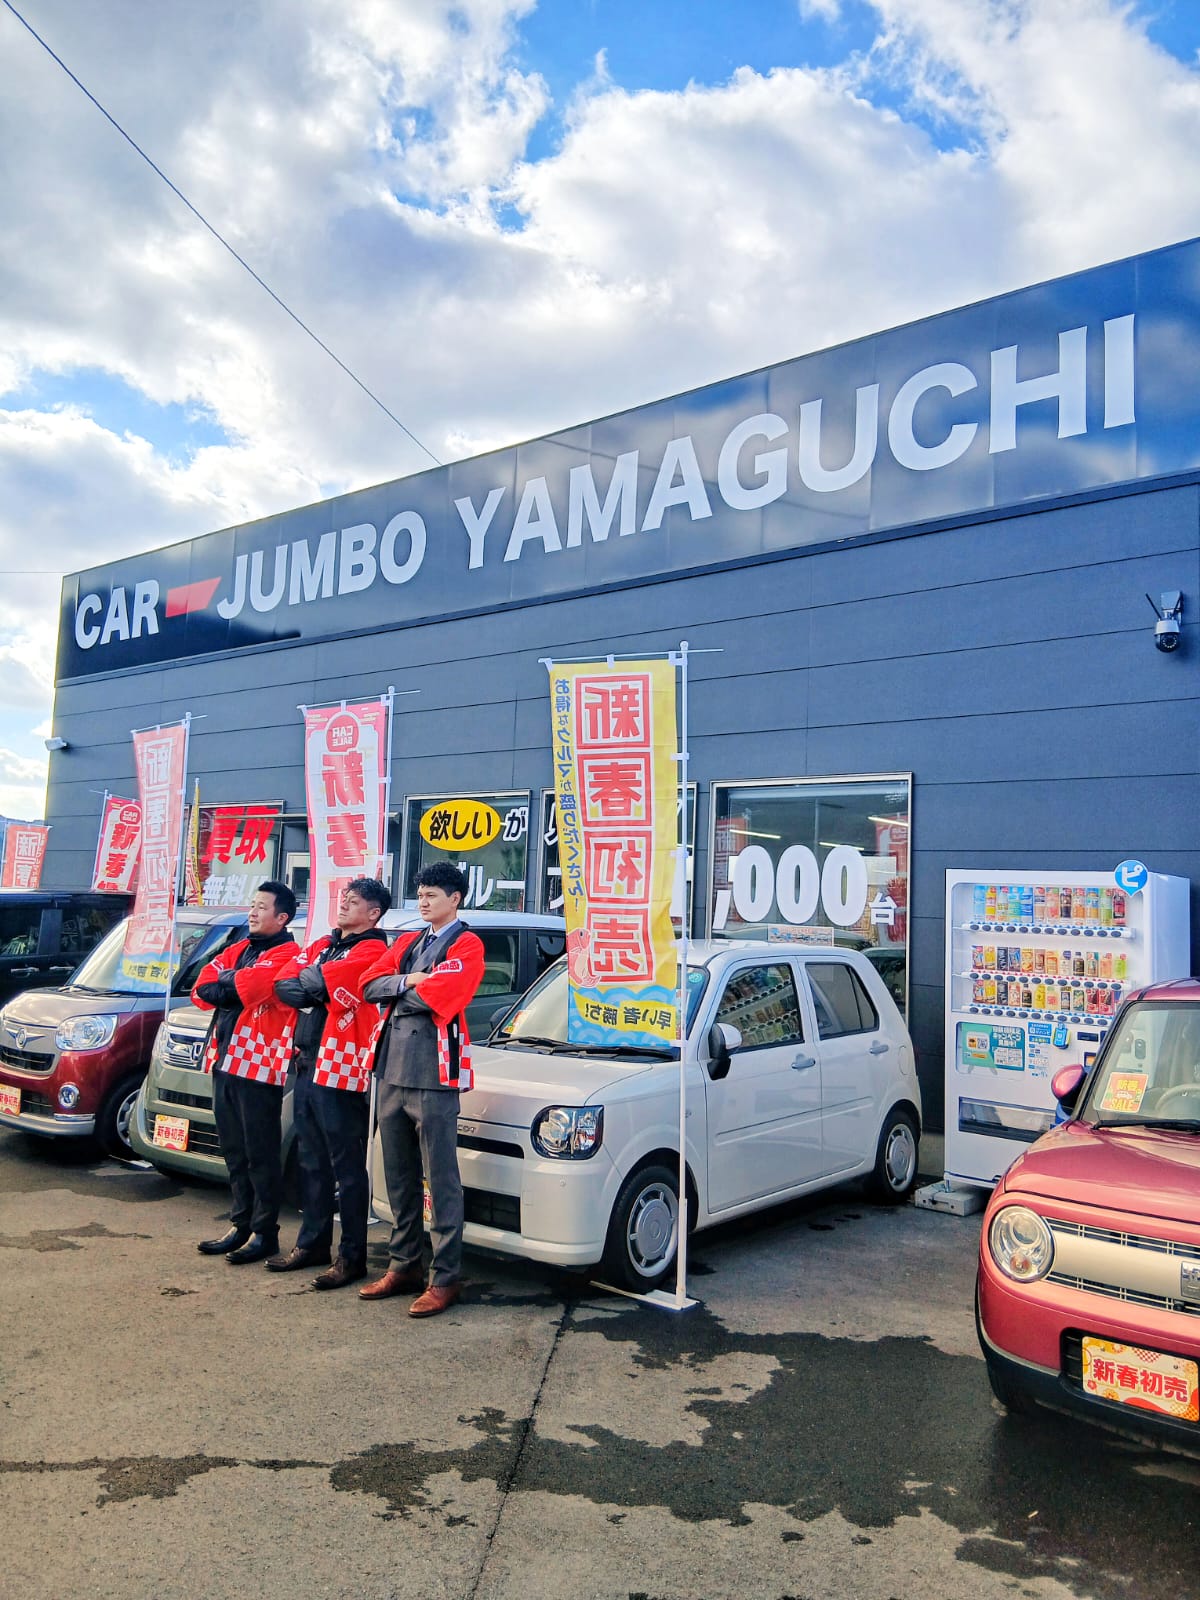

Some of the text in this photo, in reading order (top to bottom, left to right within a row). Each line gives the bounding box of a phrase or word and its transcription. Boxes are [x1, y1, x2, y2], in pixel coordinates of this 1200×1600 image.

[74, 313, 1136, 650] CAR JUMBO YAMAGUCHI
[1092, 1358, 1188, 1403] 新春初売
